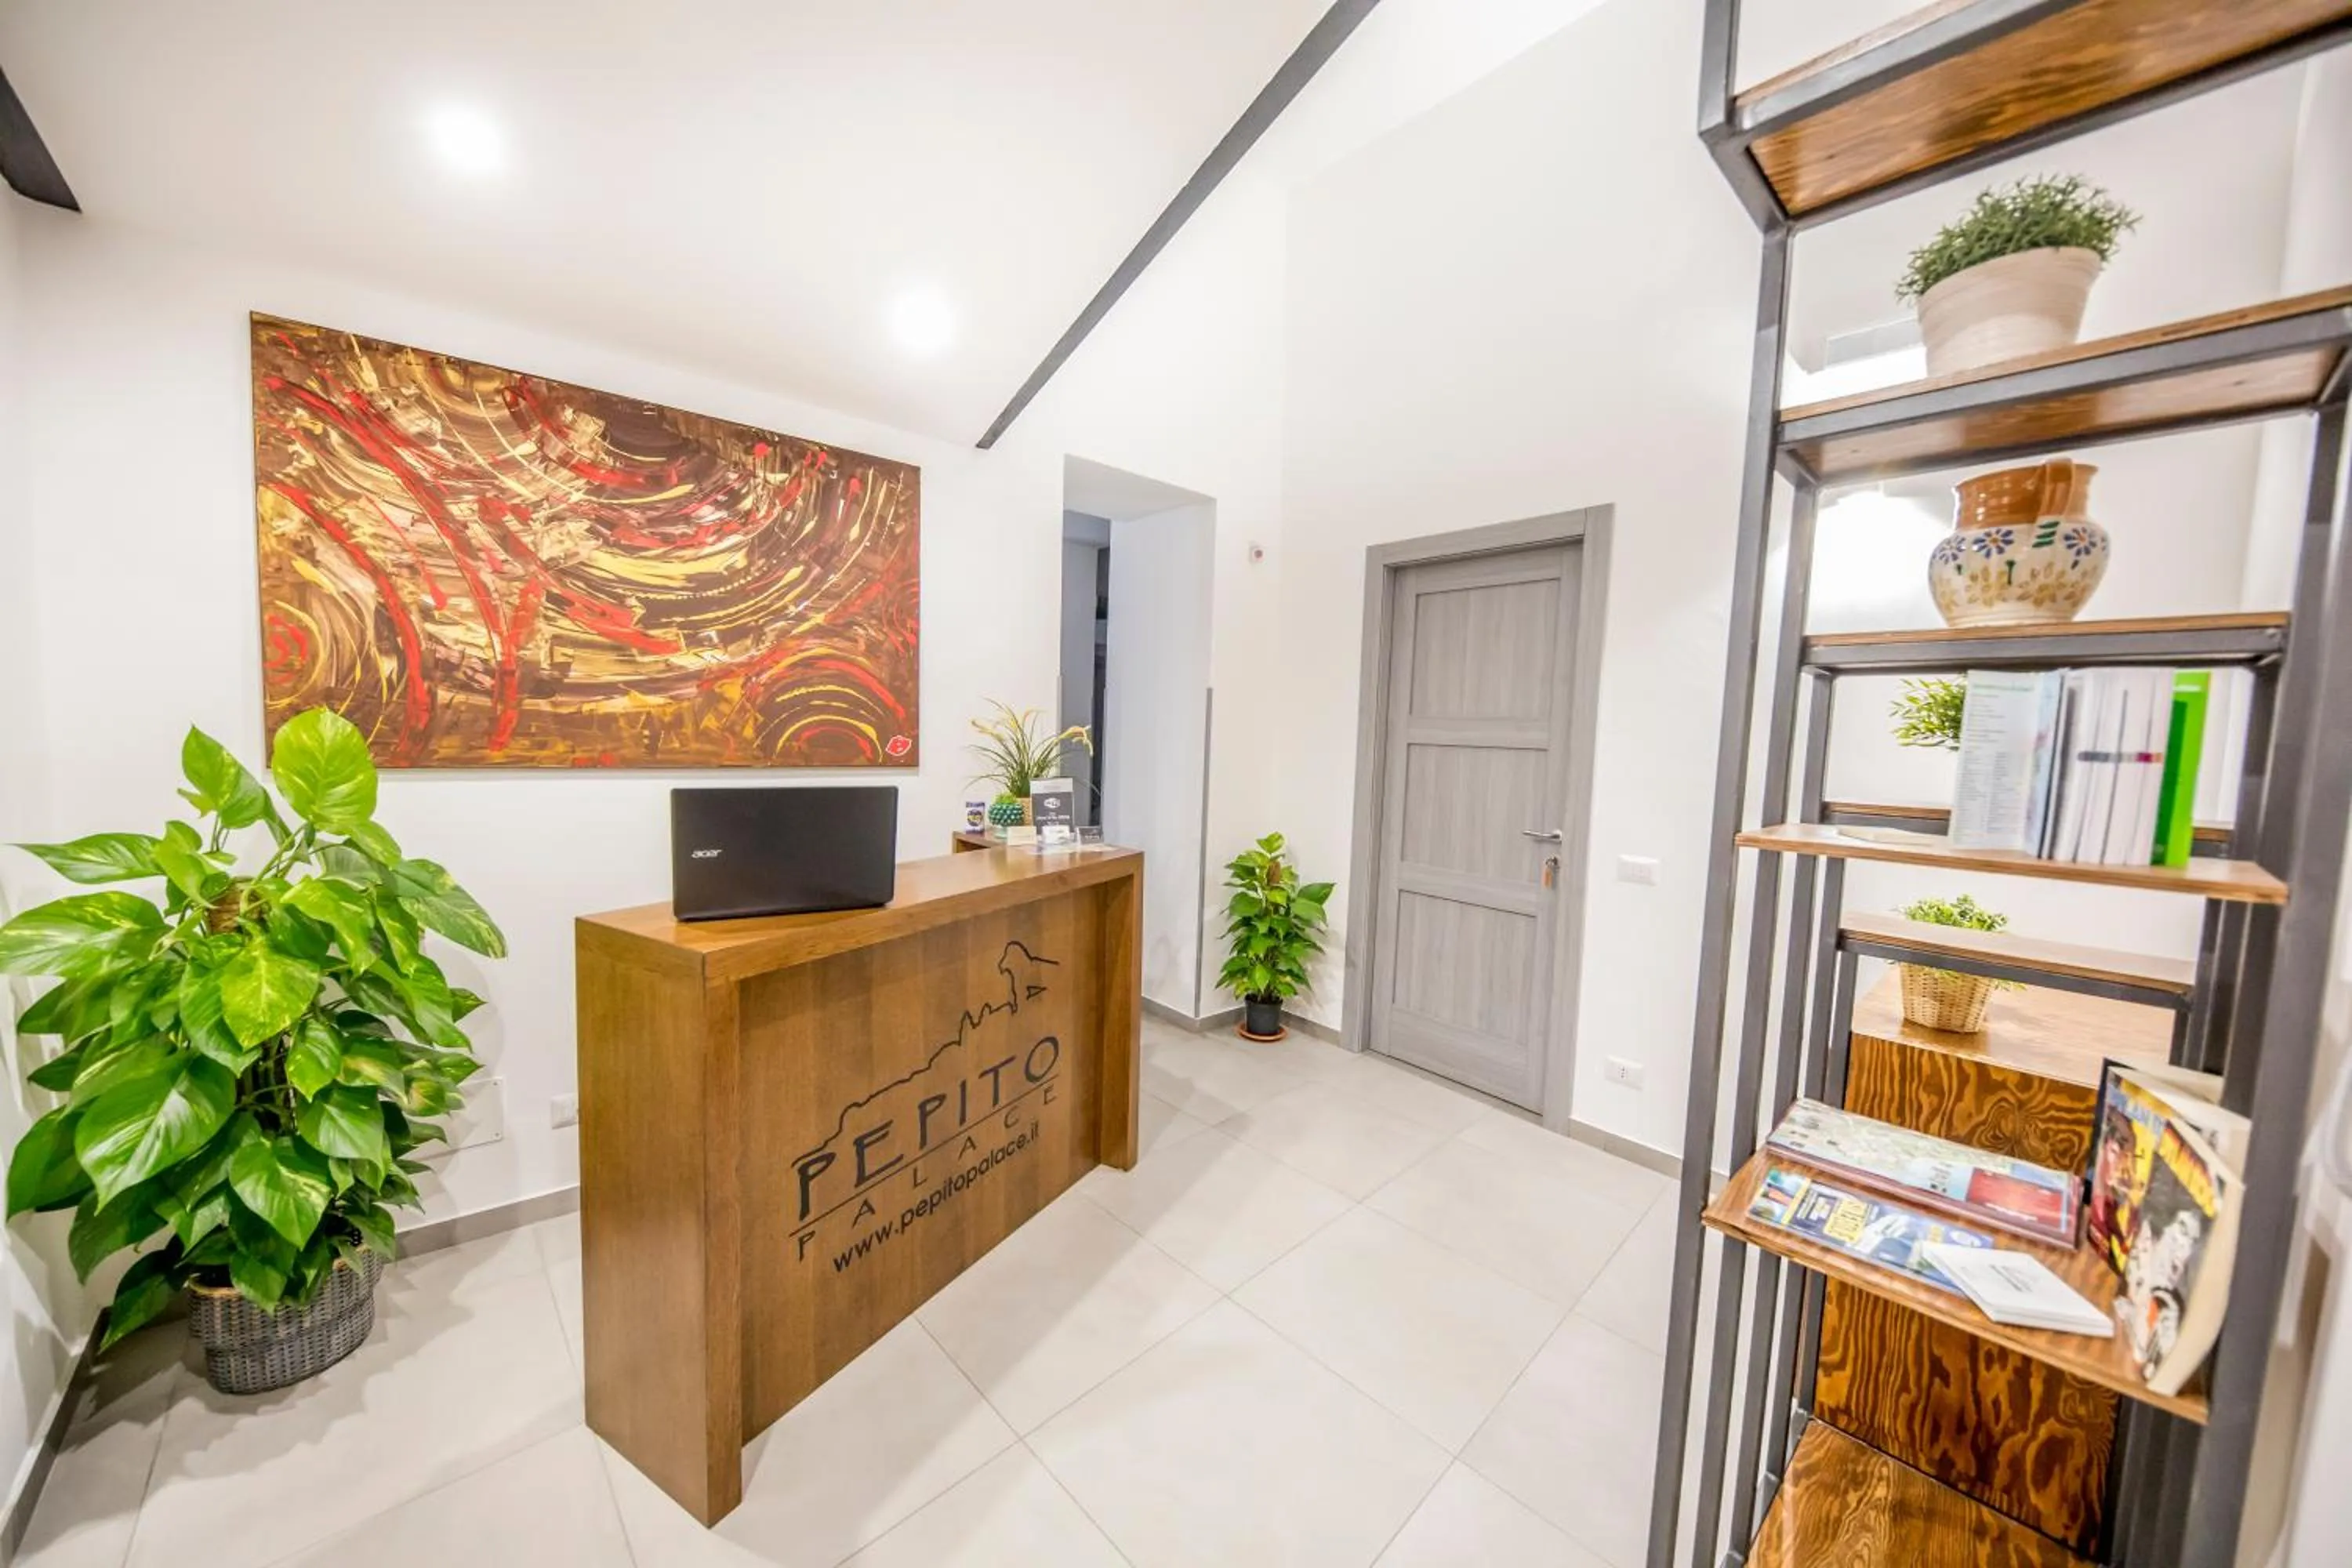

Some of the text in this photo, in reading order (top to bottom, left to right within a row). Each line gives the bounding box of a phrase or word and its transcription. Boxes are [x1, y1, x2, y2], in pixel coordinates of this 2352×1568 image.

[691, 849, 722, 858] acer
[797, 1036, 1059, 1221] PEPITO
[798, 1084, 1058, 1262] PALACE
[833, 1120, 1040, 1272] www.pepitopalace.it
